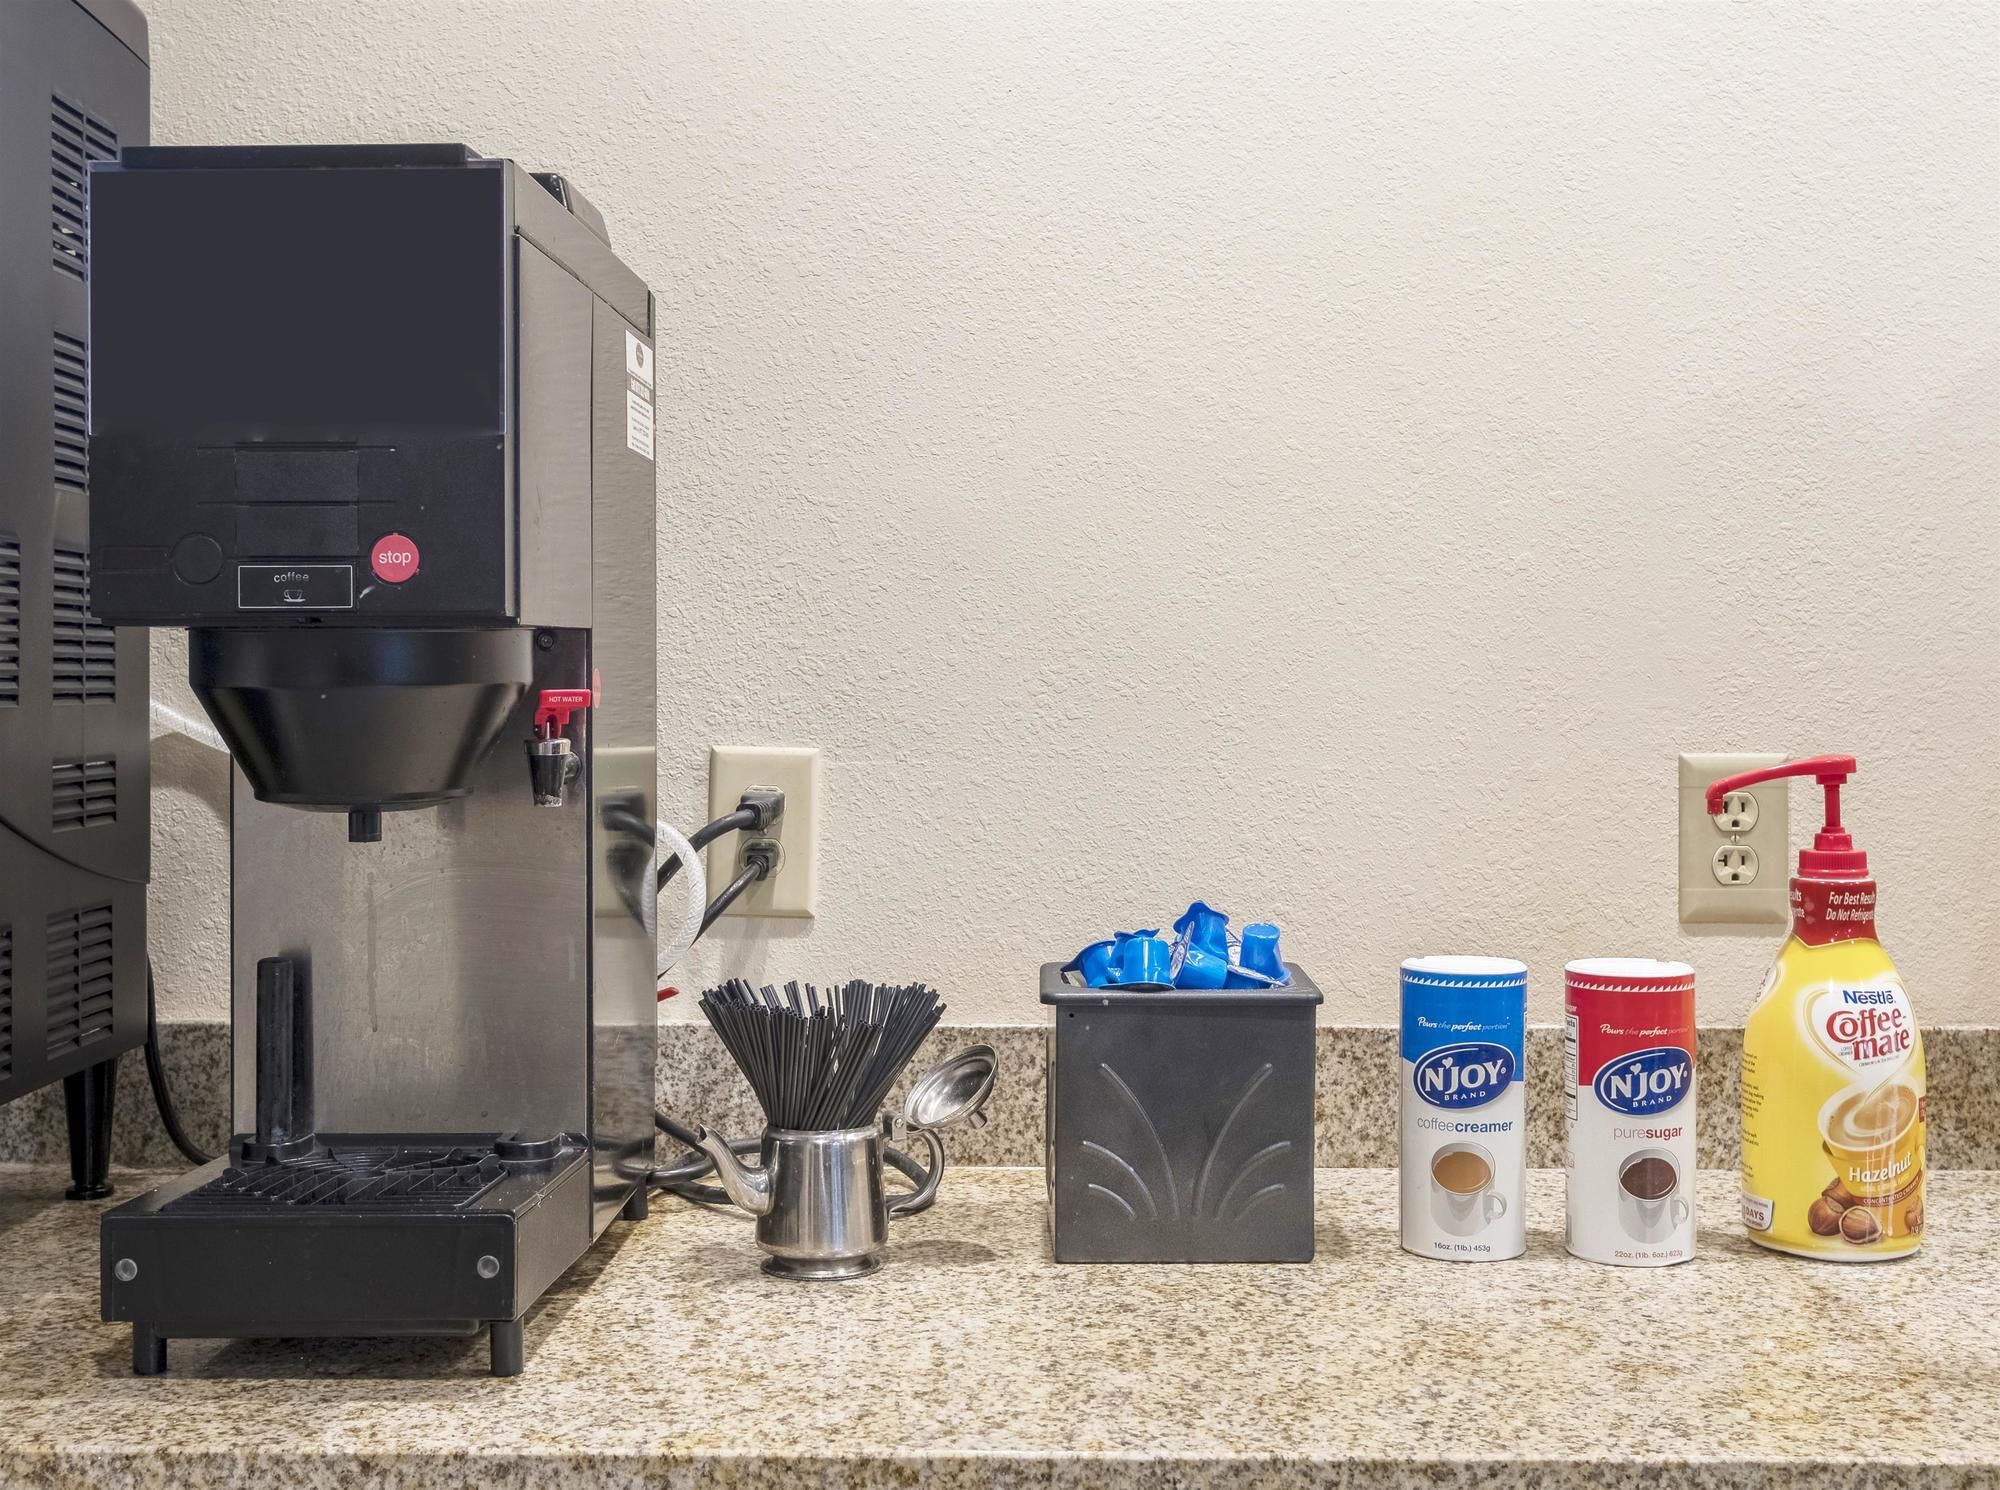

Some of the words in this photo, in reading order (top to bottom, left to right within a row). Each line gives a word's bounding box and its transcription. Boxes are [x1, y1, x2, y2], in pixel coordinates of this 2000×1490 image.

[378, 551, 412, 566] stop
[273, 571, 310, 583] coffee
[1829, 891, 1843, 904] For
[1844, 892, 1859, 905] Best
[1826, 908, 1836, 920] Do
[1837, 909, 1850, 921] Not
[1843, 990, 1894, 1005] Nestlé
[1418, 1016, 1438, 1029] Pours
[1438, 1021, 1451, 1030] the
[1451, 1021, 1482, 1032] perfect
[1600, 1023, 1624, 1035] Pours
[1625, 1027, 1638, 1036] the
[1639, 1026, 1668, 1038] perfect
[1852, 1029, 1910, 1061] mate
[1424, 1057, 1504, 1094] N'JOY
[1610, 1062, 1686, 1101] N'JOY
[1444, 1091, 1486, 1101] BRAND
[1632, 1095, 1672, 1108] BRAND
[1848, 1151, 1912, 1183] Hazelnut
[1745, 1206, 1764, 1221] DAYS
[1473, 1244, 1491, 1252] 453g
